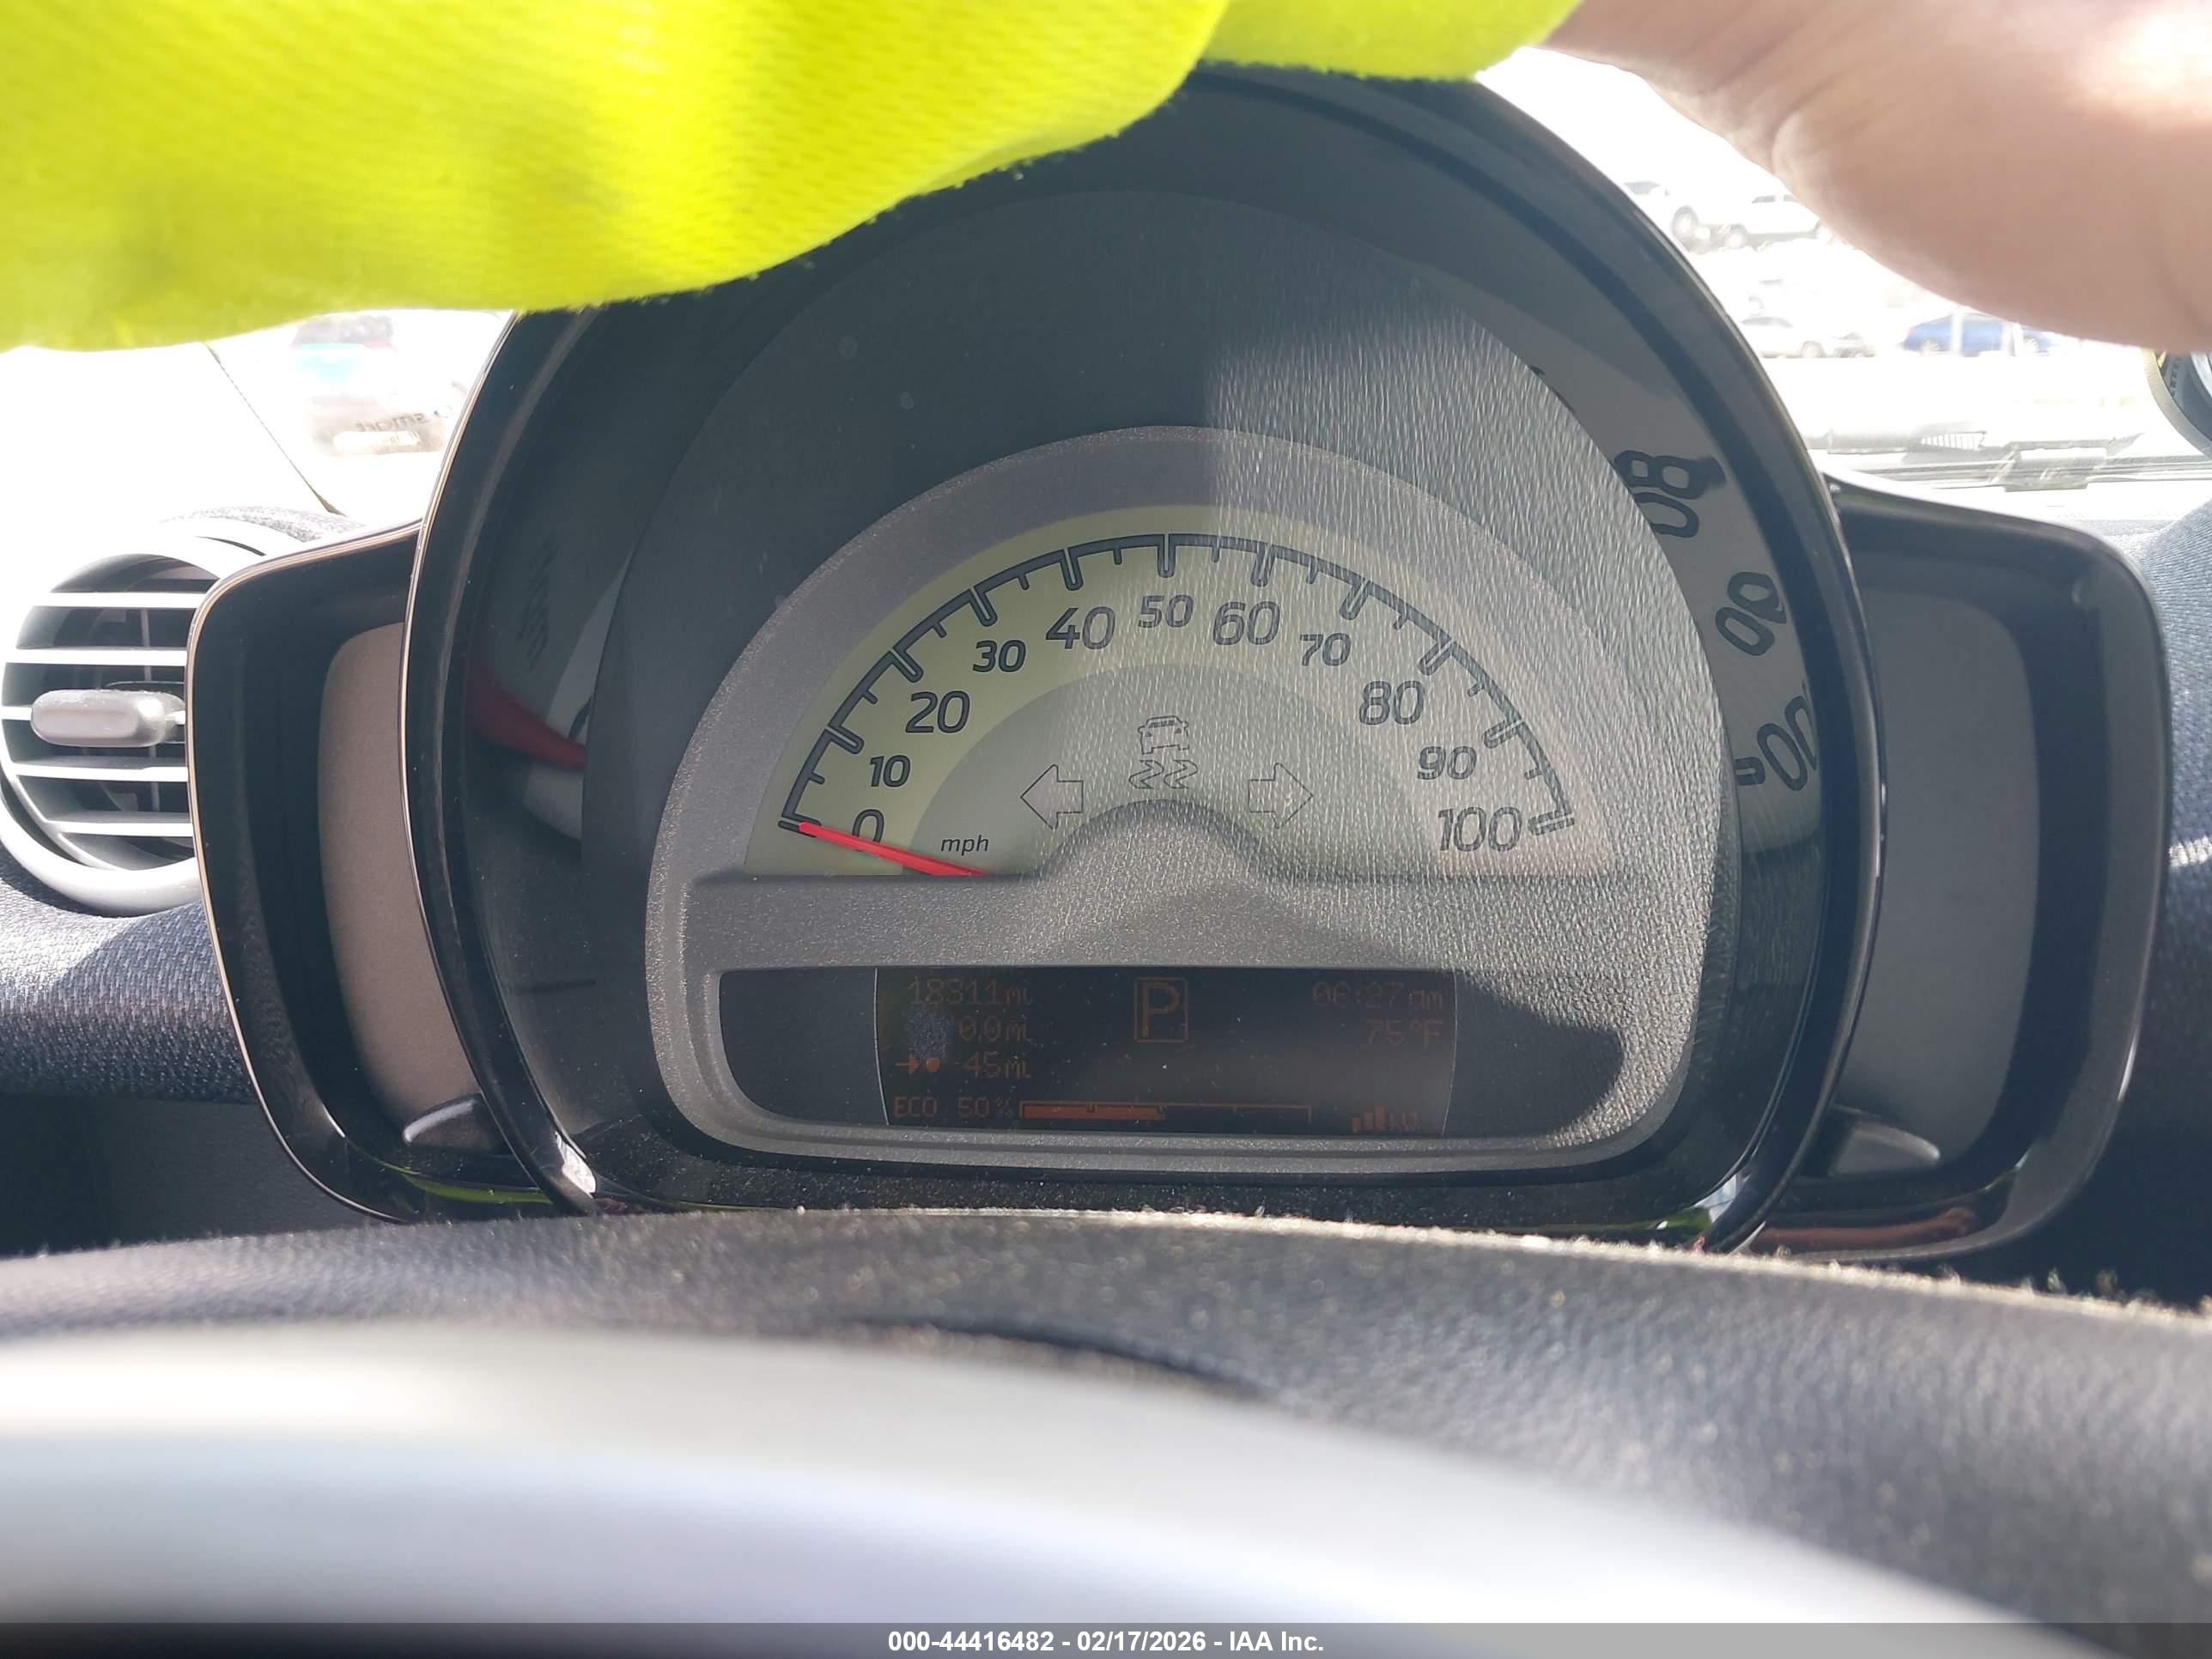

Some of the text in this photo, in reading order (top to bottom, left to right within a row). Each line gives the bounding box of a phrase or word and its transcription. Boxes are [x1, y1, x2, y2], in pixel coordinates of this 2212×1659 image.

[1045, 606, 1115, 650] 40
[1137, 595, 1194, 629] 50
[1212, 601, 1281, 647] 60
[973, 640, 1027, 673] 30
[1299, 632, 1352, 667] 70
[905, 691, 970, 734] 20
[1358, 681, 1426, 726] 80
[867, 755, 910, 788] 10
[1417, 746, 1476, 781] 90
[852, 809, 884, 852] 0
[940, 833, 990, 857] mph
[1437, 805, 1523, 853] 100
[1141, 981, 1181, 1038] P
[894, 1096, 938, 1118] ECO
